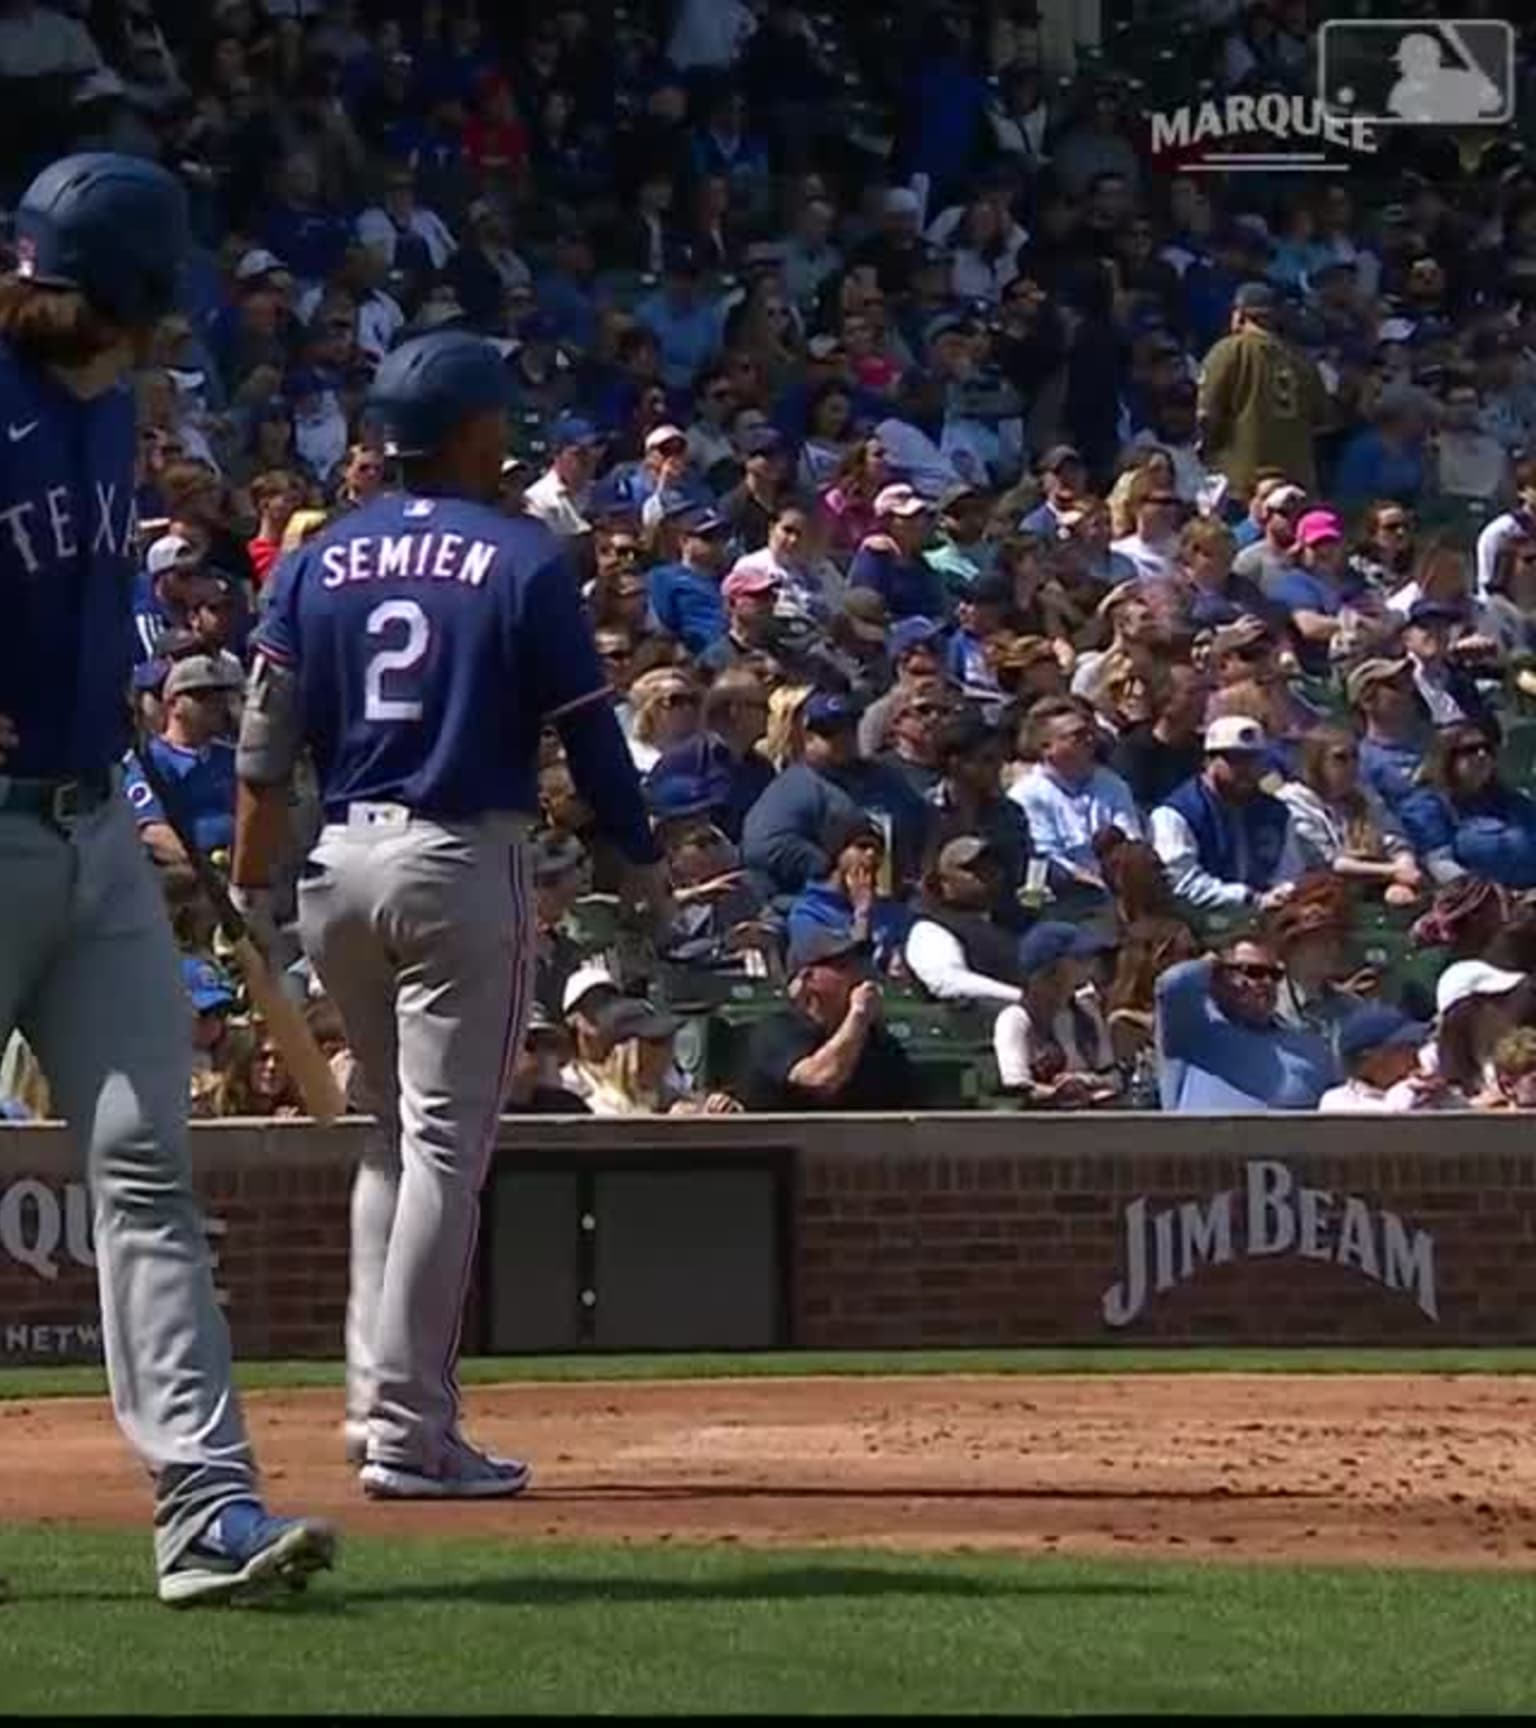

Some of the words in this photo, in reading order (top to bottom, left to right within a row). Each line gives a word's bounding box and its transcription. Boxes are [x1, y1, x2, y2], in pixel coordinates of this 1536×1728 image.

[321, 532, 497, 588] SEMIEN
[364, 599, 430, 721] 2
[1101, 1190, 1235, 1327] JIM
[1247, 1159, 1440, 1323] BEAM
[4, 1324, 99, 1351] NETW
